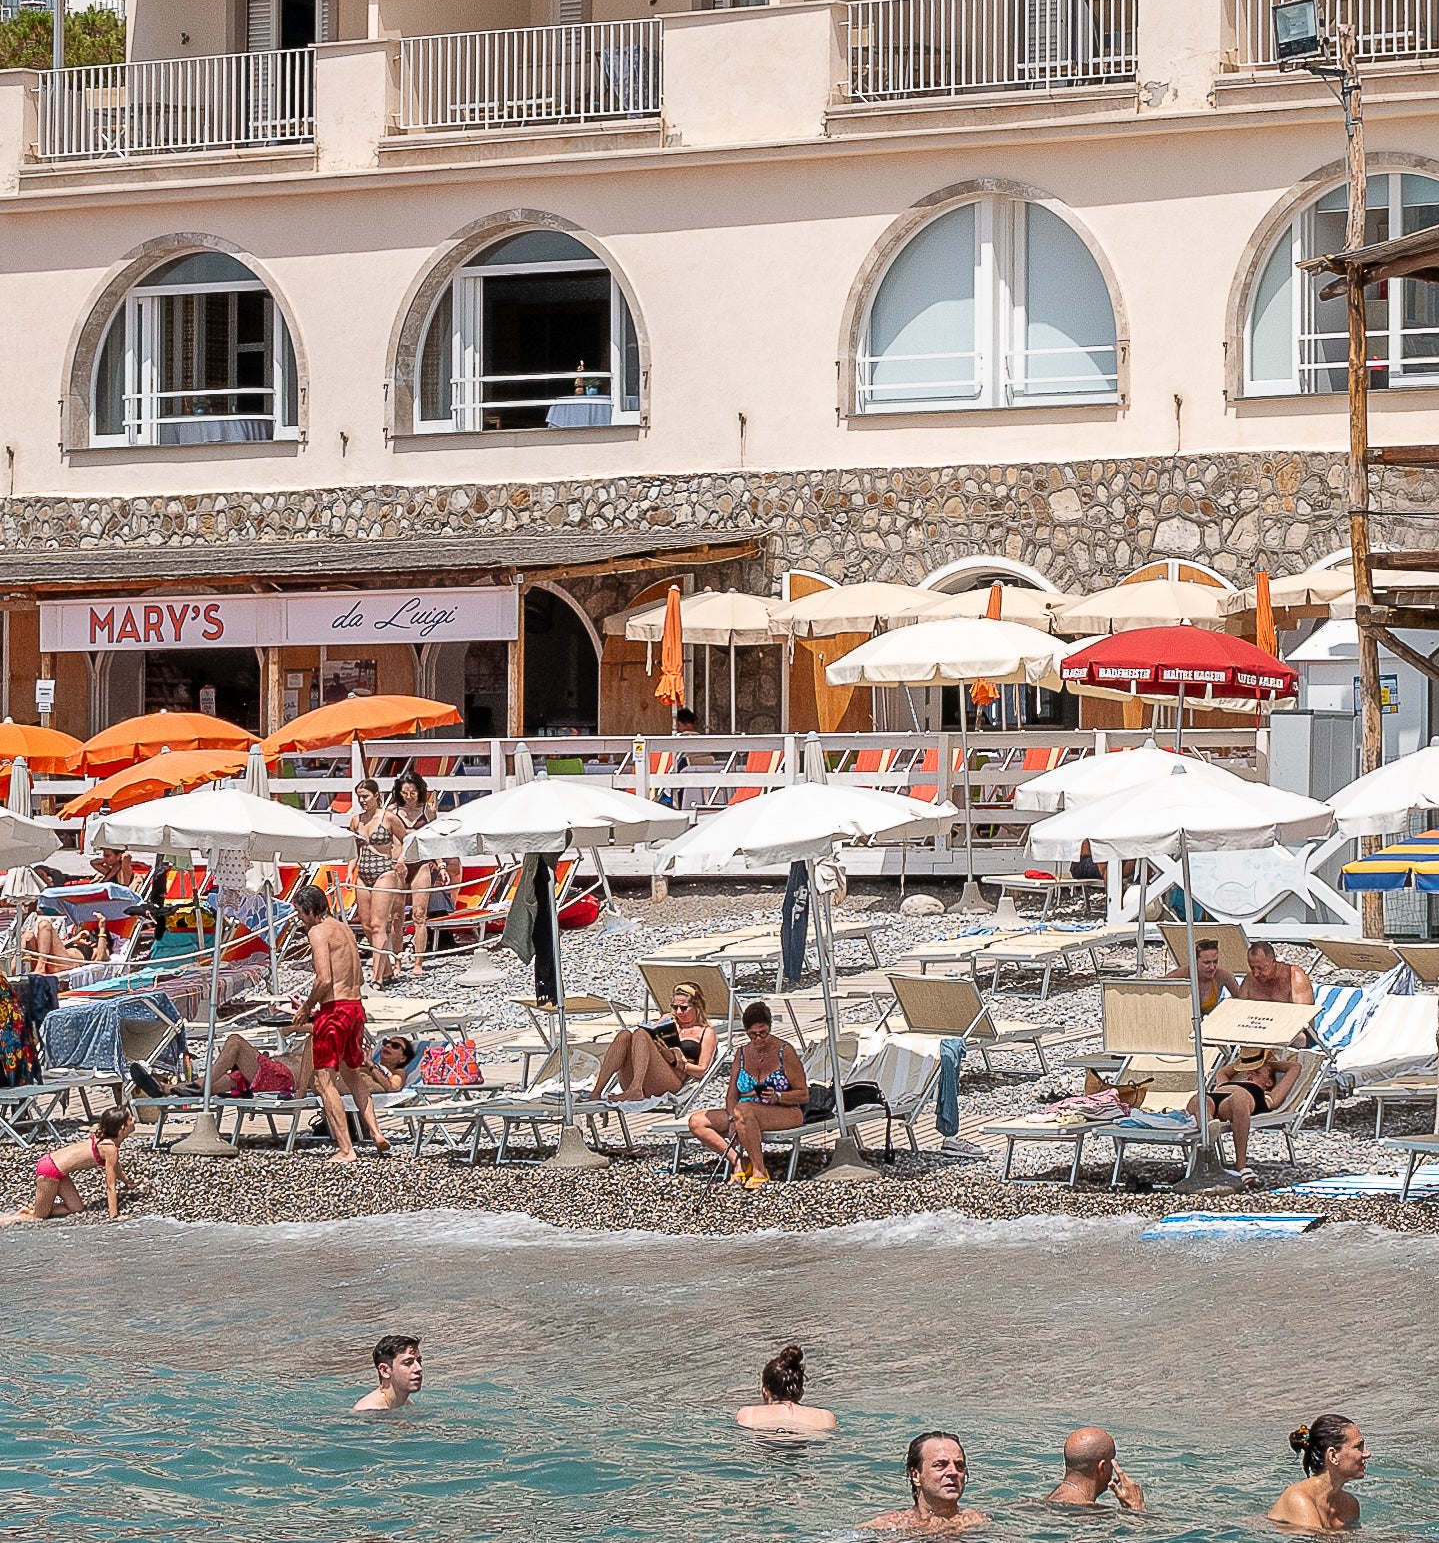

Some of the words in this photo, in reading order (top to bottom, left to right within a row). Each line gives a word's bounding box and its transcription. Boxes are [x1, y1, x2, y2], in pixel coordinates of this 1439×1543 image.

[89, 603, 225, 645] MARY'S
[332, 600, 363, 629] da
[374, 597, 459, 637] Luigi
